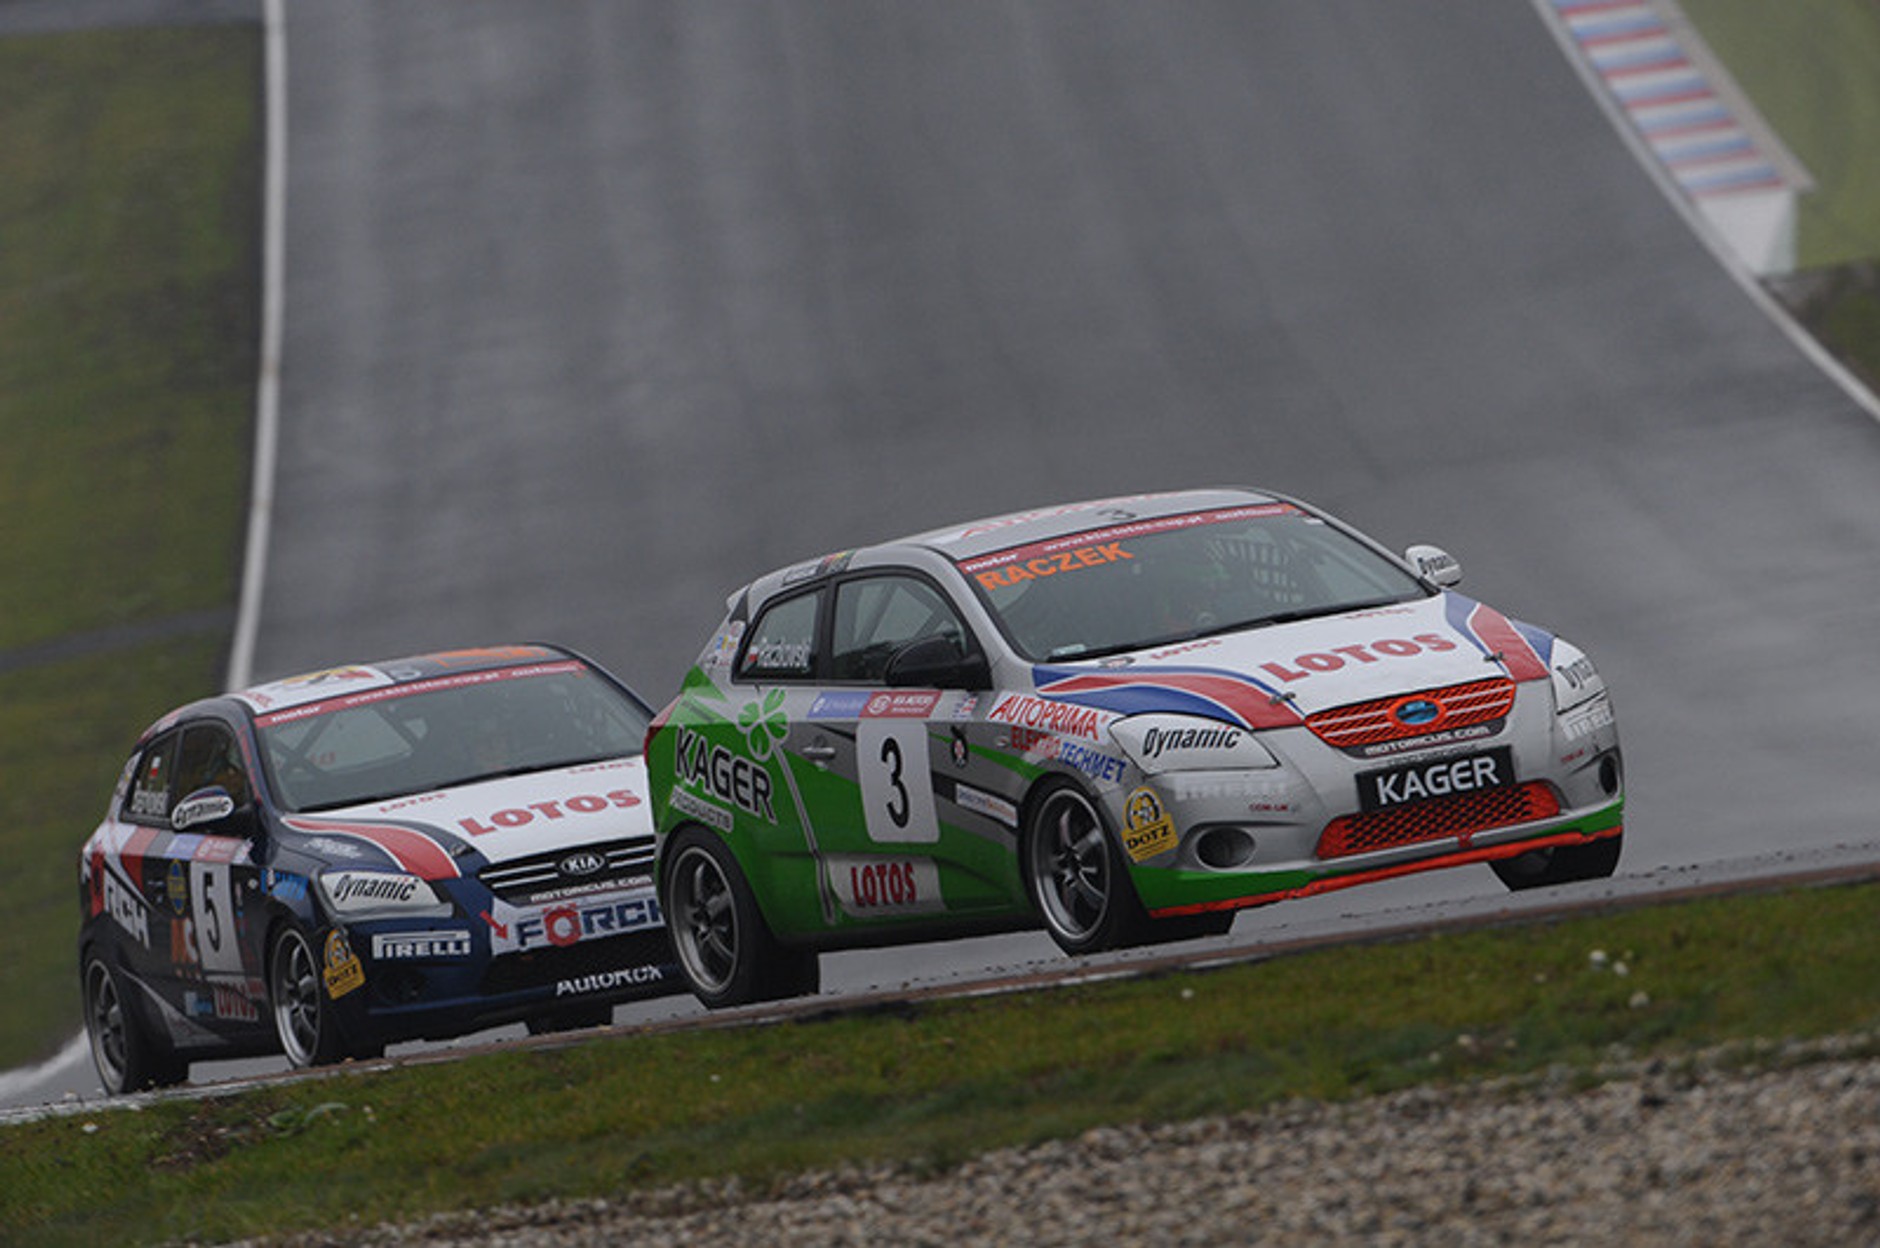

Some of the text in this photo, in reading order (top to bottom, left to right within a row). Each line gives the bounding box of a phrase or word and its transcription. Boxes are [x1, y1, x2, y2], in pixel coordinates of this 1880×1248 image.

[975, 542, 1135, 591] RACZEK
[1260, 633, 1457, 684] LOTOS
[989, 695, 1099, 741] AUTOPRIMA
[1143, 724, 1242, 758] Dynamic
[674, 724, 778, 826] KAGER
[880, 737, 910, 829] 3
[1376, 755, 1500, 805] KAGER
[458, 789, 642, 837] LOTOS
[1126, 823, 1169, 850] DOTZ
[334, 873, 417, 902] Dynamic
[569, 857, 598, 873] KIA
[851, 862, 917, 907] LOTOS
[203, 871, 220, 952] 5
[371, 930, 471, 959] PIRELLI
